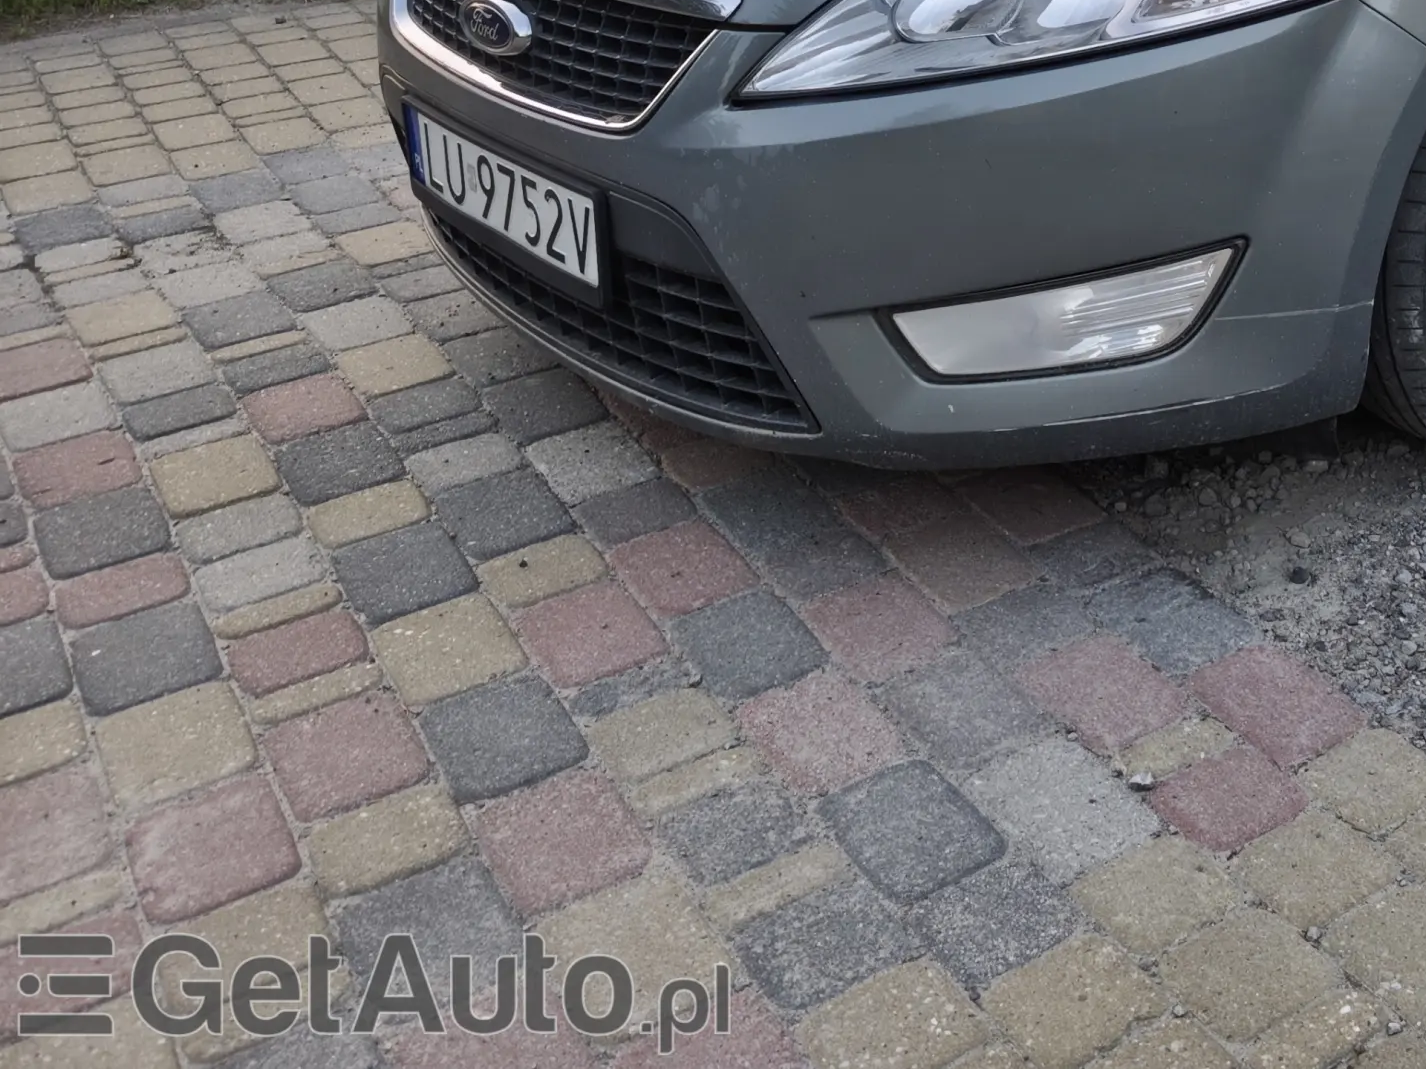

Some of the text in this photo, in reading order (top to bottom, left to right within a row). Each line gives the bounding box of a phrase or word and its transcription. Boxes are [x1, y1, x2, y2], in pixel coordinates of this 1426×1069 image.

[470, 8, 500, 40] Ford
[423, 122, 590, 275] LU 9752V
